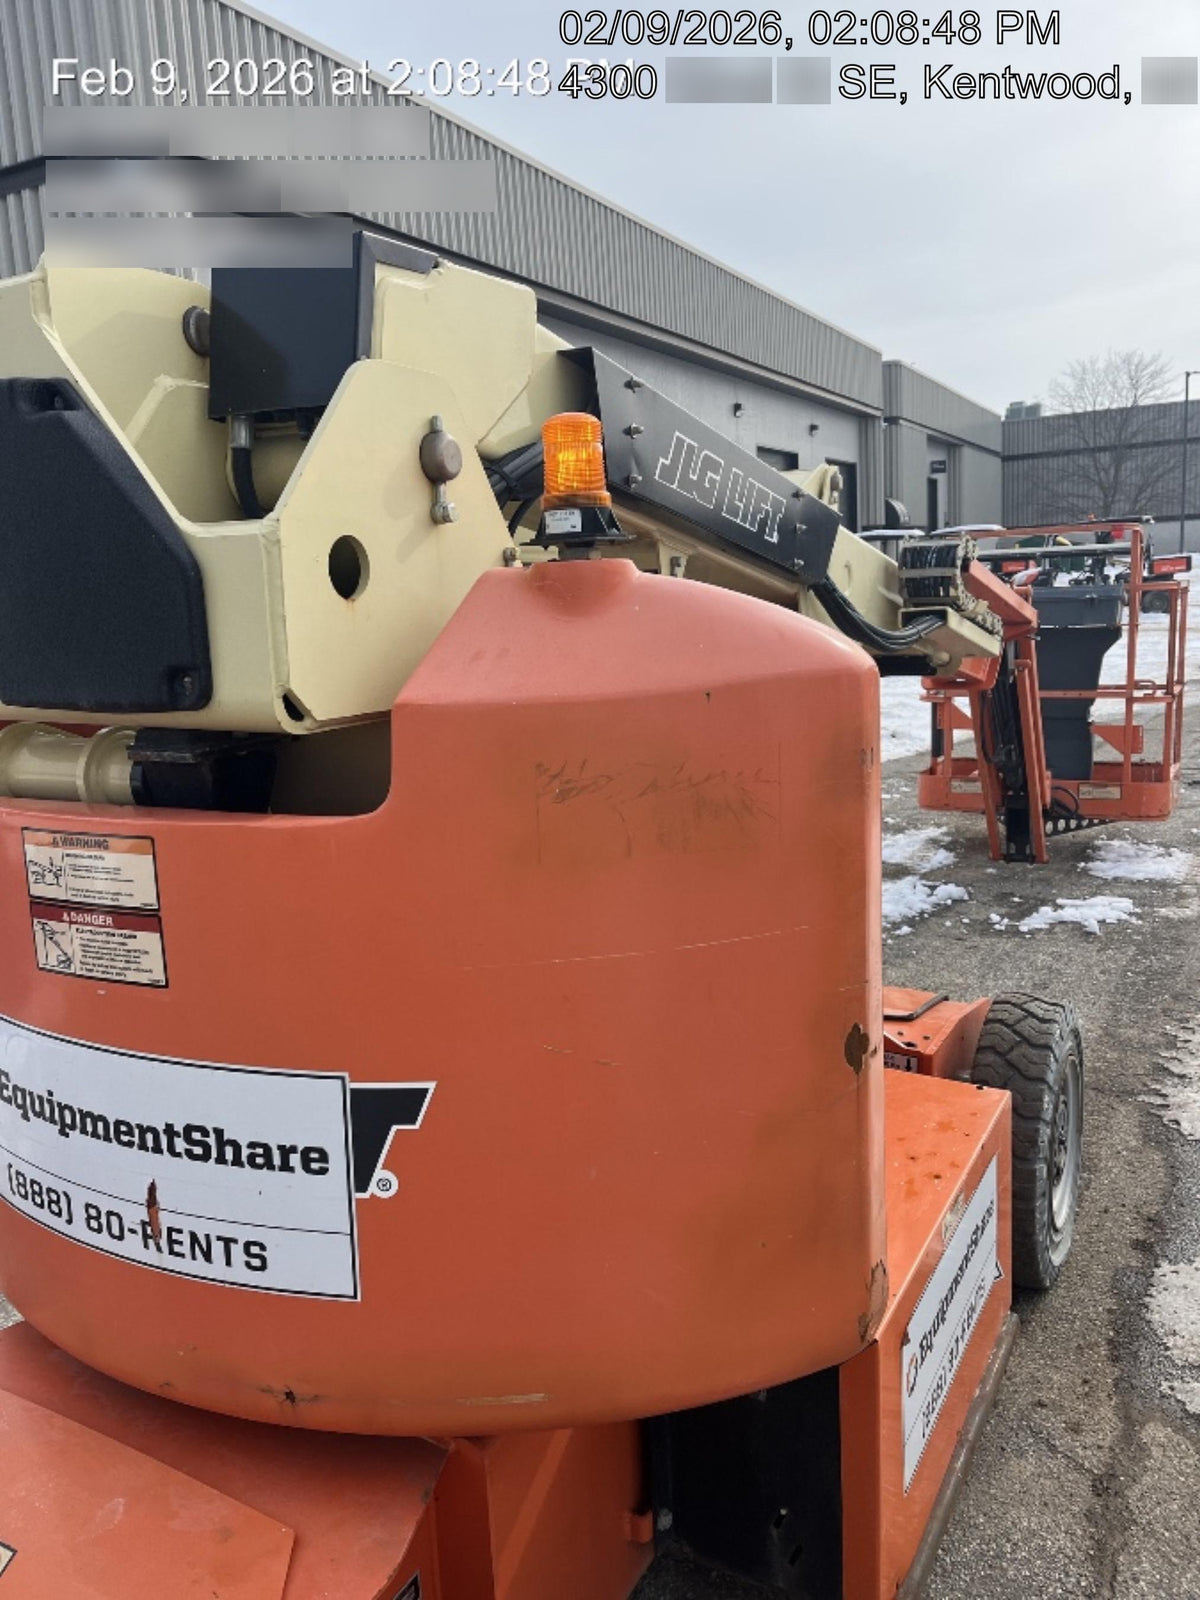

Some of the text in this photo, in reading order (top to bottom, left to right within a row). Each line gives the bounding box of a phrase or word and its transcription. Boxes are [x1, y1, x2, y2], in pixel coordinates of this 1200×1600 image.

[654, 430, 787, 544] JLG LIFT
[60, 836, 109, 850] WARNING
[70, 912, 114, 926] DANGER
[8, 1163, 74, 1225] (888)
